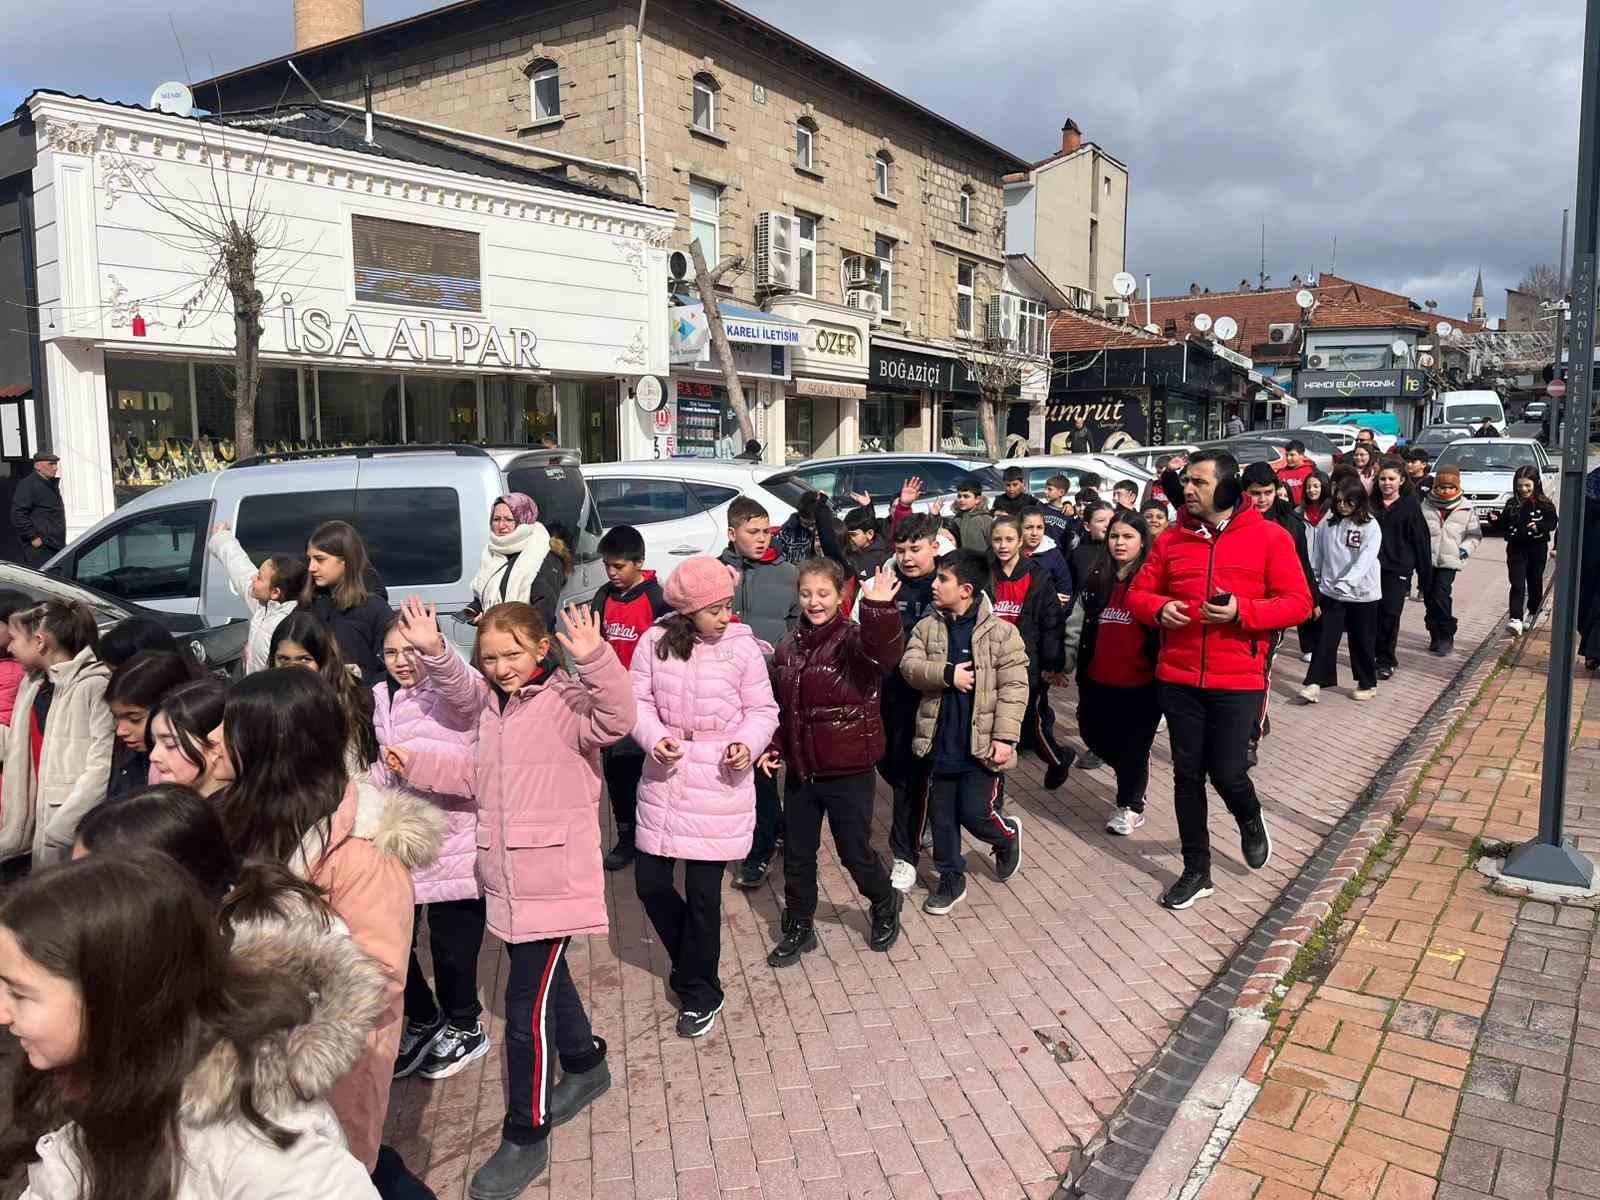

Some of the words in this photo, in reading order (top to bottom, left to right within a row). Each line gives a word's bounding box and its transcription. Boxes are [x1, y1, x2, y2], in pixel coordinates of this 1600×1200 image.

[281, 292, 375, 356] İSA
[386, 317, 541, 368] ALPAR
[880, 358, 940, 387] BOĞAZİÇİ
[1046, 396, 1125, 421] ümrüt
